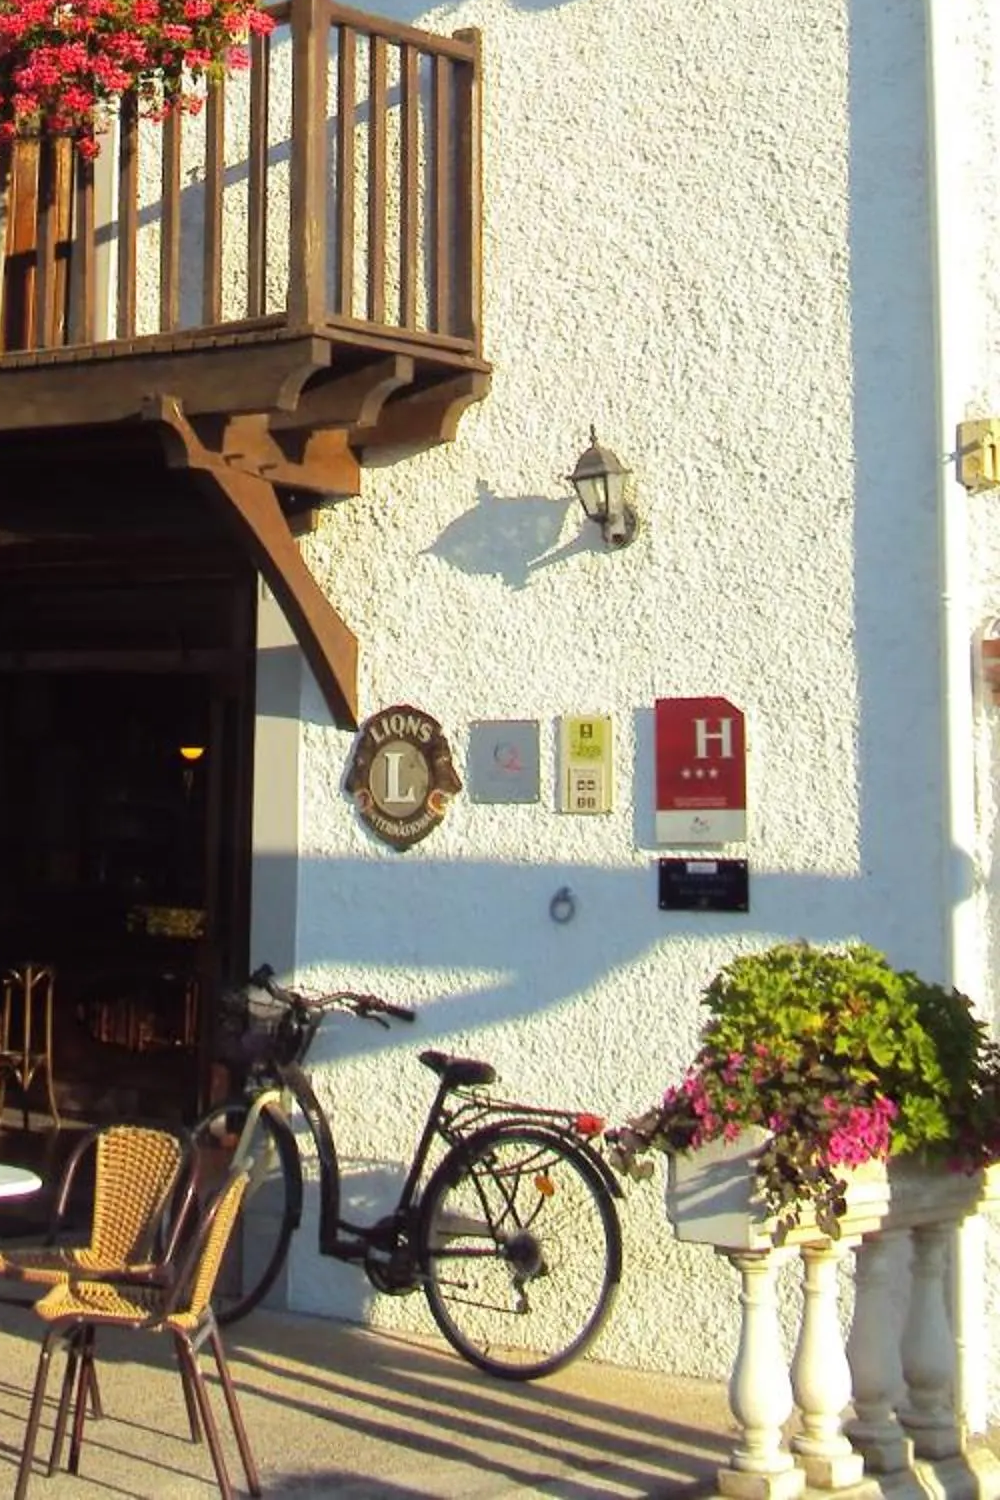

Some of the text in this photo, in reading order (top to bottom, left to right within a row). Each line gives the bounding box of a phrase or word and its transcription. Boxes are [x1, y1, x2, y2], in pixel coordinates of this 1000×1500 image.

[370, 713, 434, 744] LIONS
[692, 717, 734, 759] H
[383, 751, 417, 804] L
